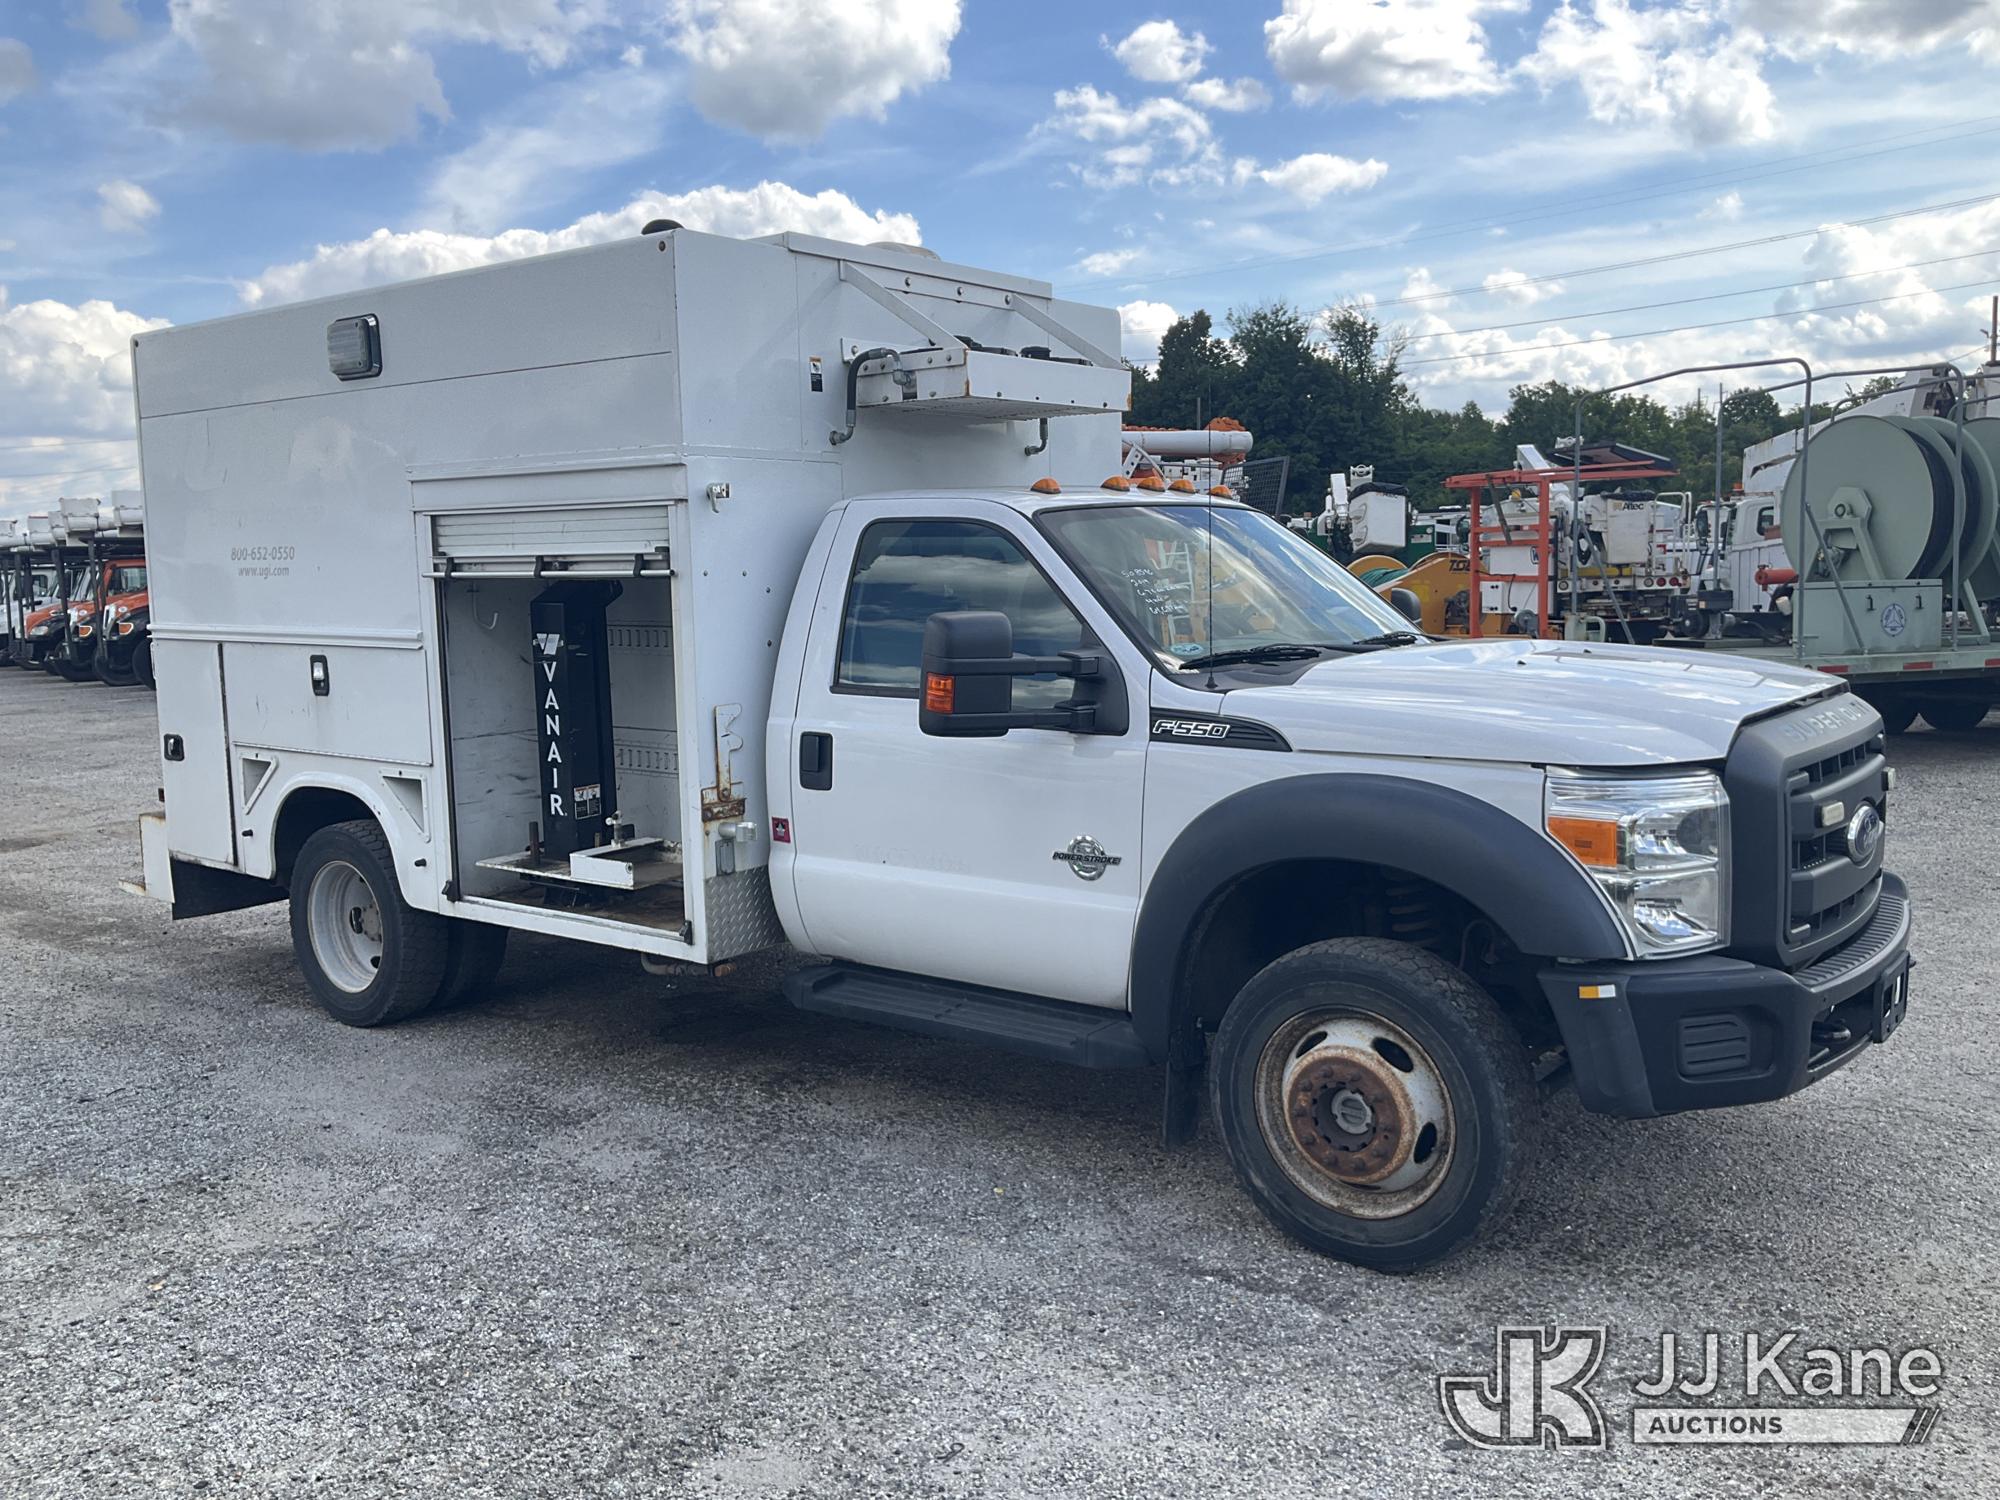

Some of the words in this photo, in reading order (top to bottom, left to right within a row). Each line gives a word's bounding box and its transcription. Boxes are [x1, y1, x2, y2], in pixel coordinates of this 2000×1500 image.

[1622, 502, 1645, 511] Altec
[231, 546, 296, 561] 800-652-0550
[238, 566, 290, 580] www.ugi.com
[1152, 719, 1231, 739] F-550
[542, 660, 565, 817] VANAIR
